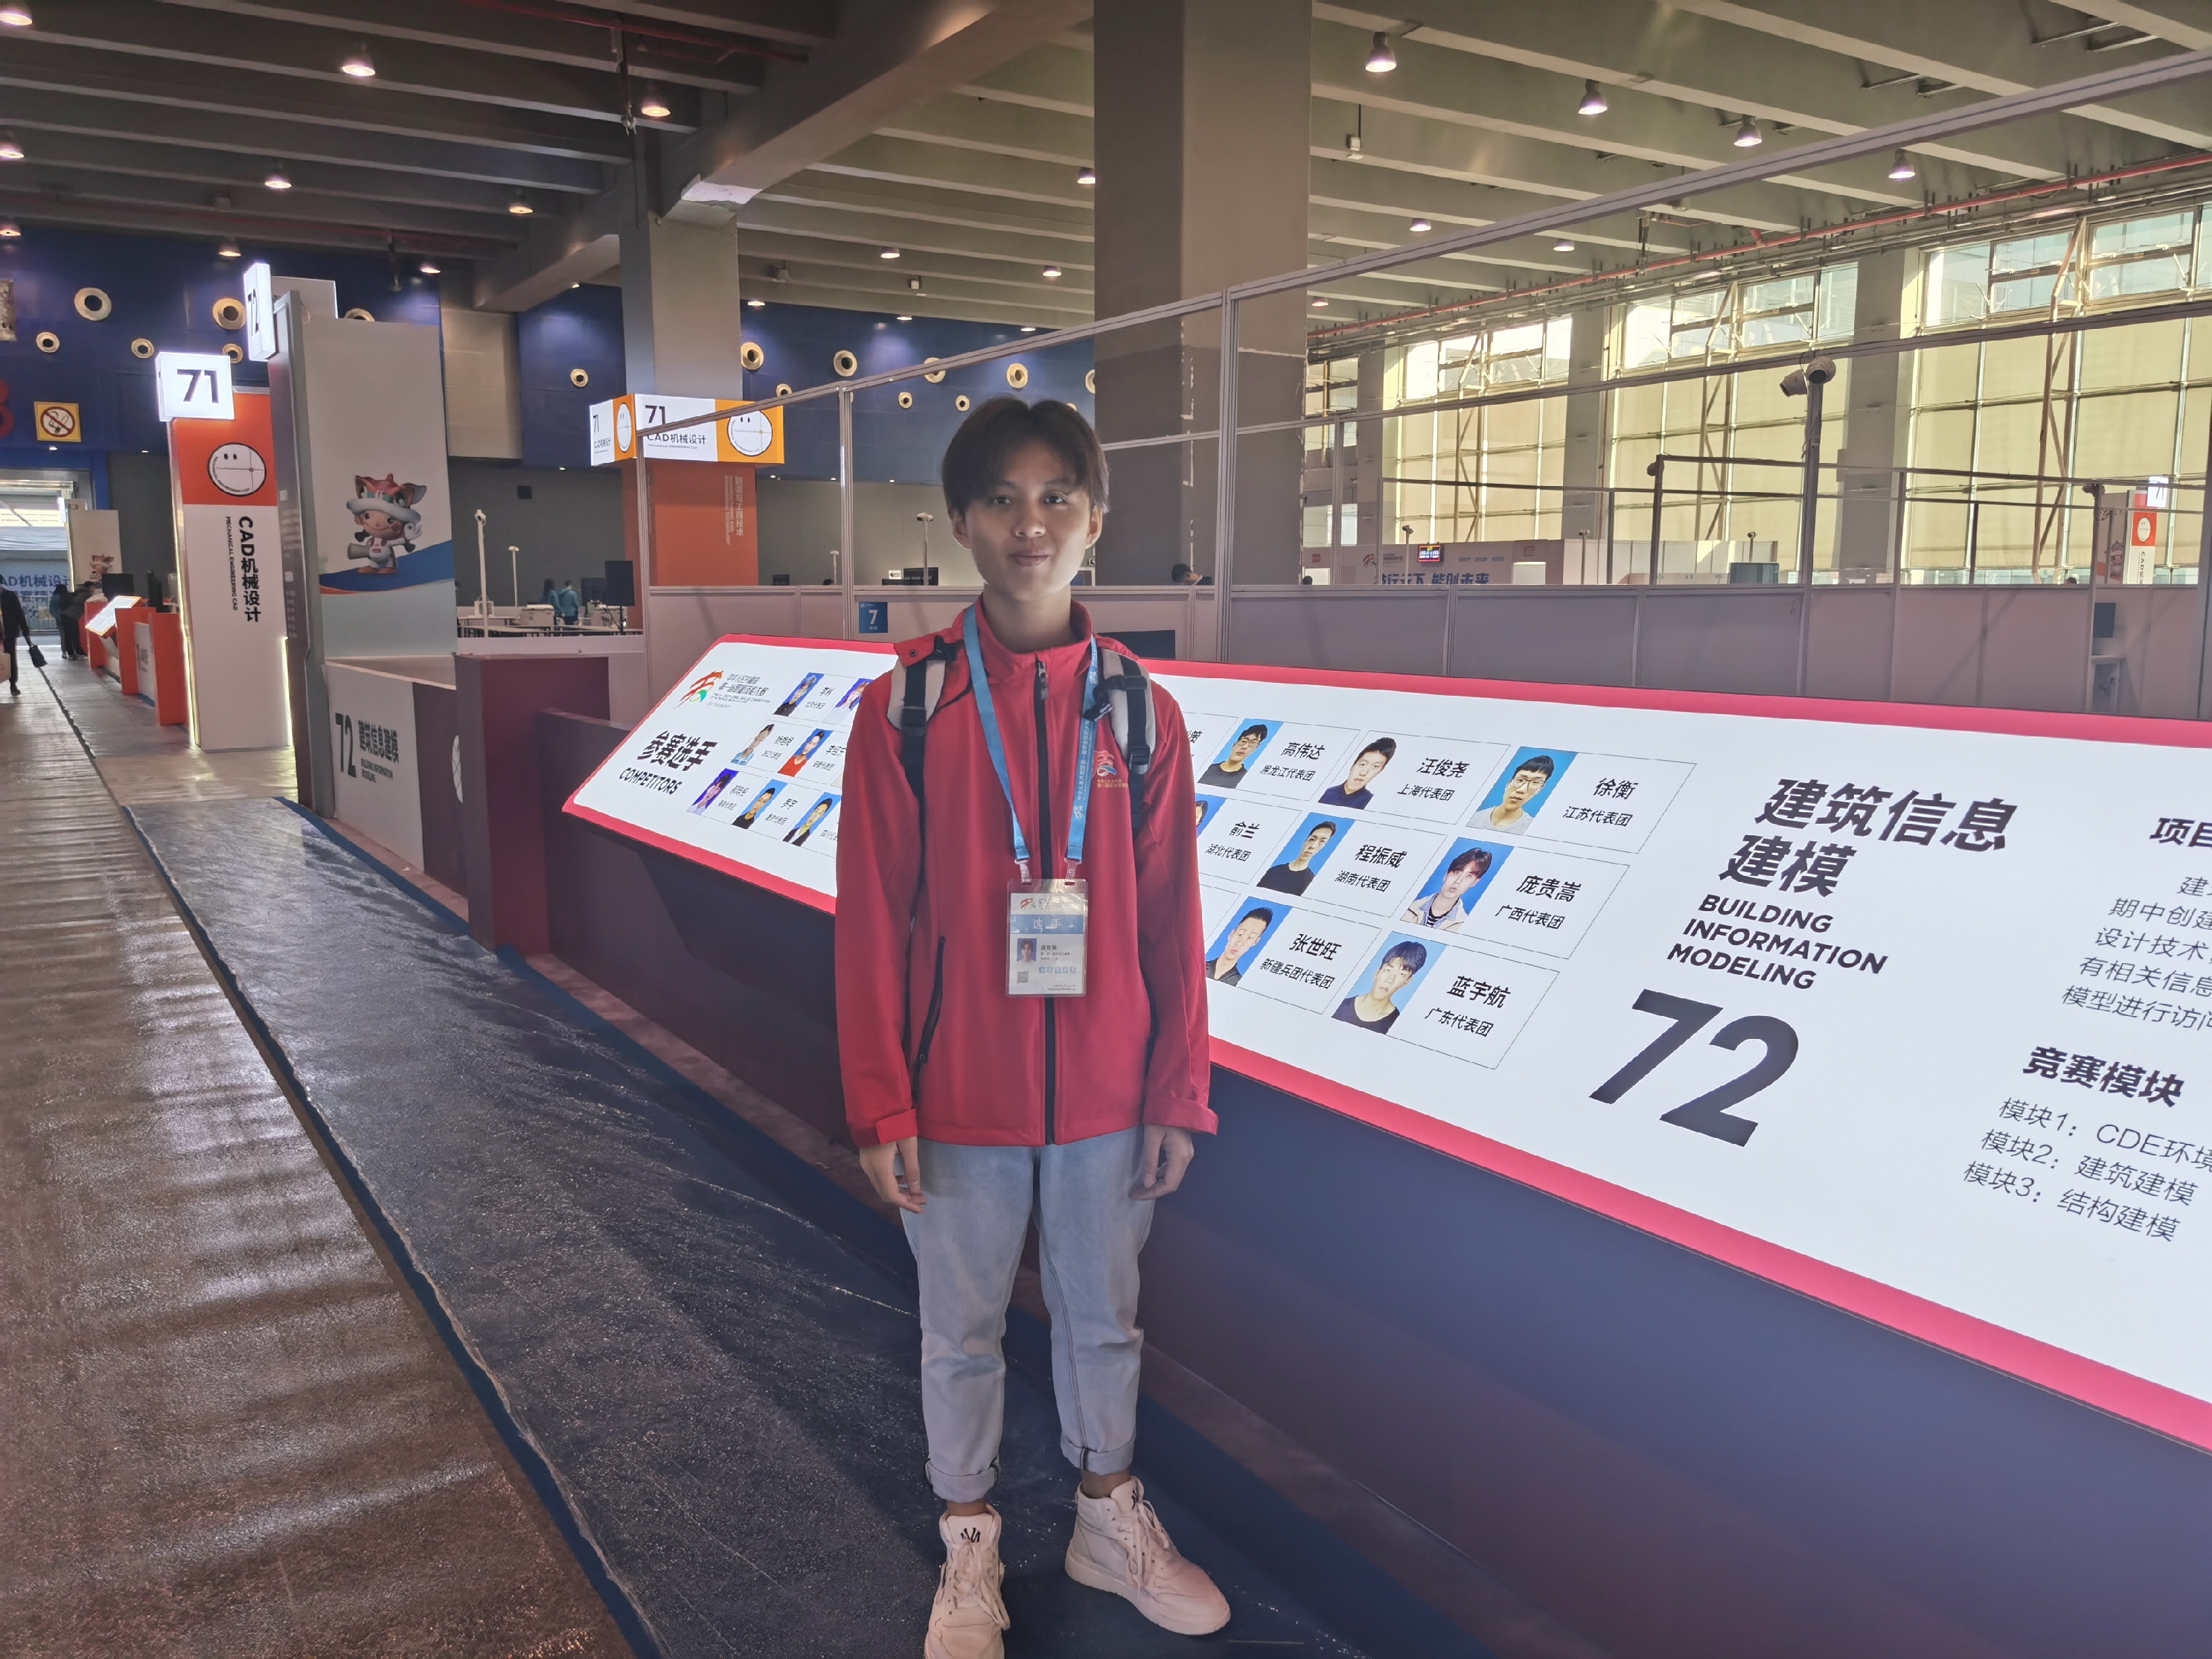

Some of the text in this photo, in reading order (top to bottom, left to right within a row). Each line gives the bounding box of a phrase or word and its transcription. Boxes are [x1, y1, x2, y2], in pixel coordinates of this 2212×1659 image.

[248, 288, 259, 336] 72
[177, 369, 219, 403] 71
[645, 405, 665, 424] 71
[647, 433, 707, 445] CAD机械设计
[239, 516, 261, 622] CAD机械设计
[868, 609, 878, 625] 7
[335, 713, 357, 778] 72
[637, 730, 718, 771] 参赛选手
[1281, 742, 1325, 759] 高伟达
[1260, 765, 1316, 781] 黑龙江代表团
[1416, 757, 1470, 778] 汪俊尧
[619, 768, 682, 795] COMPETITORS
[1397, 783, 1455, 801] 上海代表团
[1593, 778, 1639, 799] 徐衡
[1562, 805, 1633, 826] 江苏代表团
[1755, 778, 2018, 853] 建筑信息
[1229, 821, 1260, 839] 俞兰
[1205, 843, 1252, 862] 湖北代表团
[1354, 844, 1407, 868] 程振威
[1718, 834, 1857, 898] 建模
[1334, 870, 1392, 892] 湖南代表团
[1516, 875, 1582, 902] 庞贵嵩
[2176, 877, 2212, 897] 建
[1495, 904, 1566, 929] 广西代表团
[1698, 893, 1832, 934] BUILDING
[2108, 898, 2212, 930] 期中创建
[1289, 933, 1342, 960] 张世旺
[1683, 918, 1888, 975] INFORMATION
[1260, 958, 1335, 989] 新疆兵团代表团
[1667, 943, 1817, 990] MODELING
[1446, 975, 1511, 1008] 蓝宇航
[1424, 1007, 1494, 1037] 广东代表团
[1589, 988, 1800, 1148] 72
[2022, 1046, 2184, 1107] 竞赛模块
